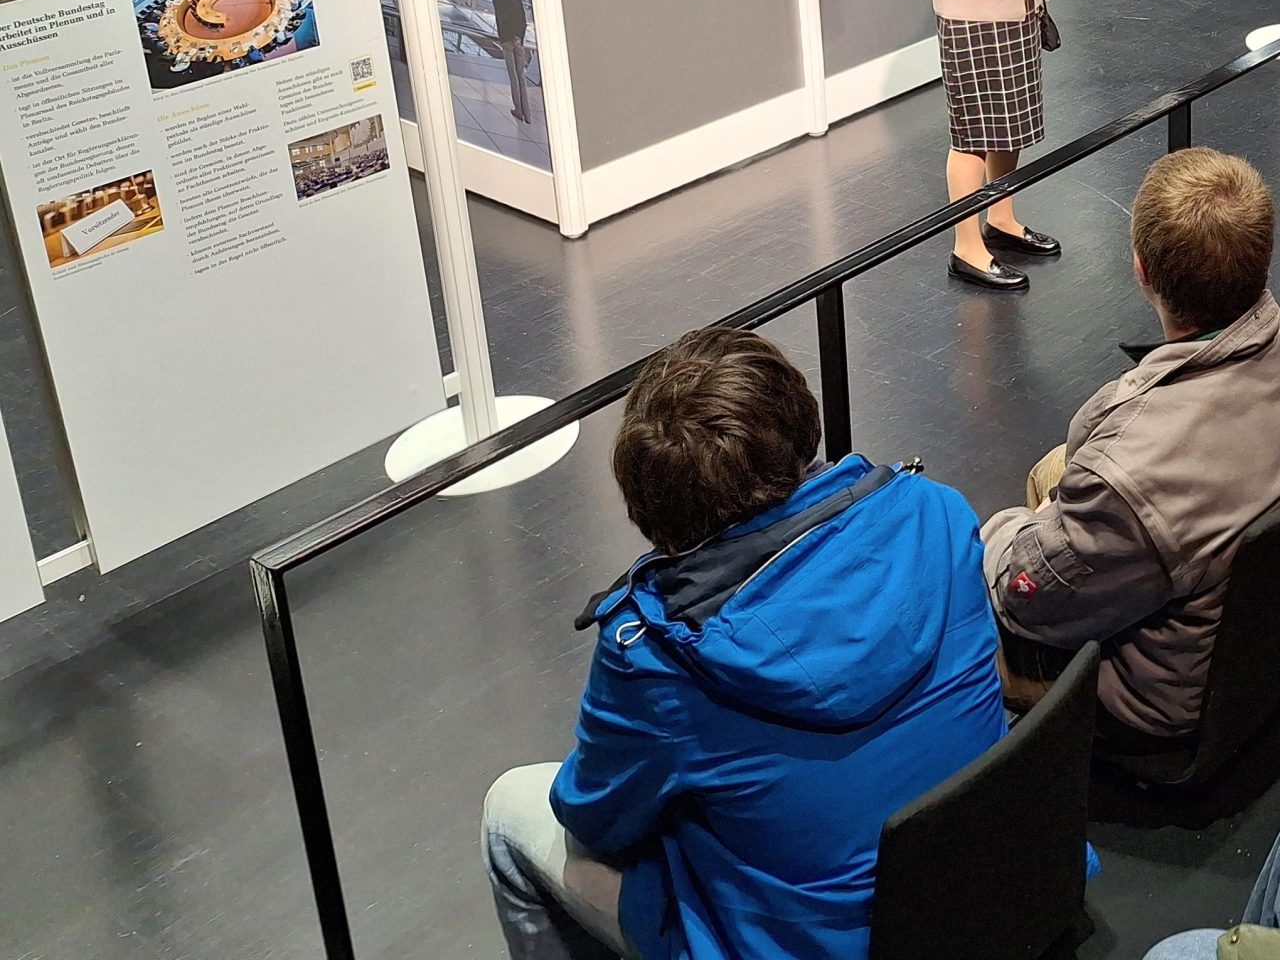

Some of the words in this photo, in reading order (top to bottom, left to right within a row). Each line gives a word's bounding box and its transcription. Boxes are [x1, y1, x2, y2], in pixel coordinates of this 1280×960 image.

[13, 14, 56, 28] Deutsche
[58, 2, 105, 17] Bundestag
[49, 16, 84, 29] Plenum
[86, 9, 104, 19] und
[0, 33, 58, 51] Ausschüssen
[82, 210, 120, 235] Vorsitzender
